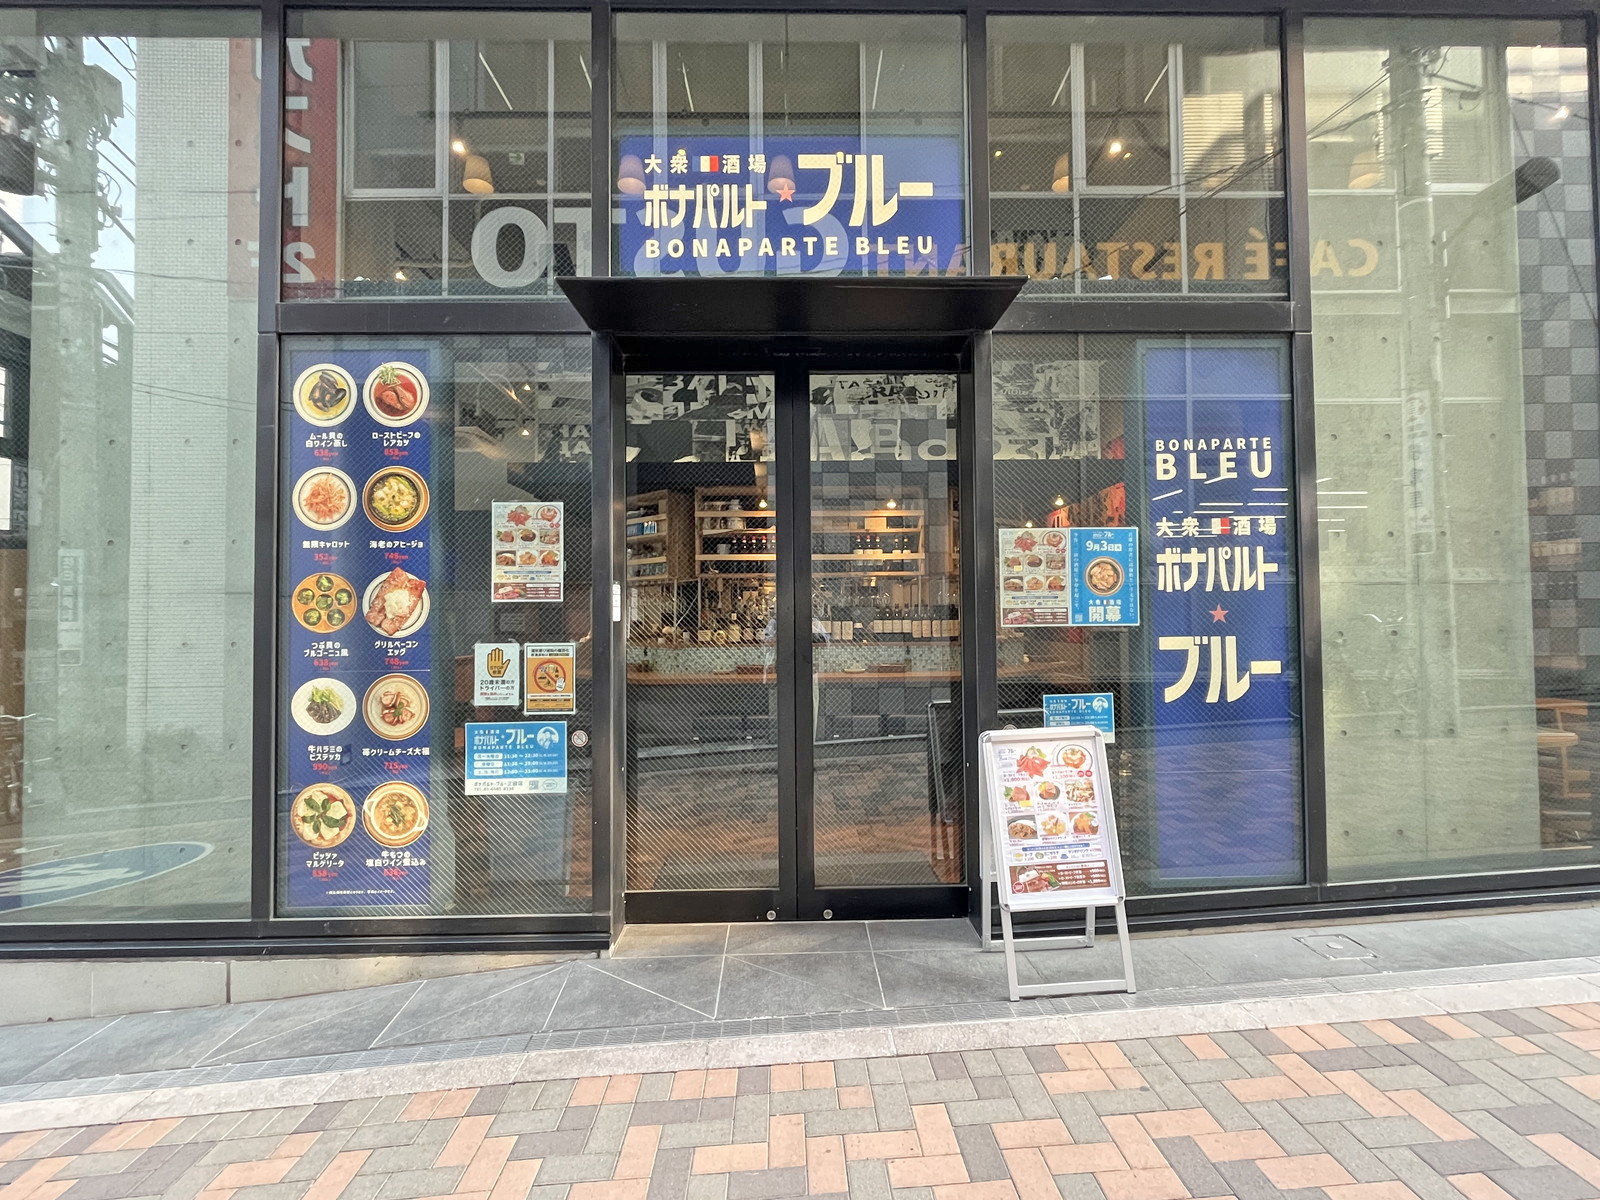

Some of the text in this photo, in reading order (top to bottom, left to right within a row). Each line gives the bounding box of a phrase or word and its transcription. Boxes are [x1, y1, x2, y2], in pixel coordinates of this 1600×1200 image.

[797, 152, 934, 228] ブルー
[643, 183, 768, 229] ボナパルト
[645, 235, 934, 259] BONAPARTE BLEU
[309, 432, 344, 440] ムール貝の
[372, 431, 421, 440] ローストビーフの
[305, 440, 348, 448] 白ワイン蒸し
[1155, 437, 1273, 453] BONAPARTE
[1156, 451, 1273, 481] BLEU
[302, 540, 350, 549] 無限キャロット
[369, 540, 424, 549] 海老のアヒージョ
[1156, 546, 1279, 593] ボナパルト
[1088, 606, 1122, 623] 開幕
[311, 641, 341, 649] つぶ貝の
[374, 640, 419, 648] グリルベーコン
[303, 649, 349, 657] ブルゴーニュ風
[387, 648, 406, 656] エッグ
[1159, 635, 1282, 704] ブルー
[1070, 698, 1092, 710] ブルー
[506, 728, 535, 745] ブルー
[308, 745, 343, 753] 牛ハラミの
[362, 747, 430, 756] 苺クリームチーズ大福
[313, 852, 338, 860] ピッツァ
[306, 860, 345, 868] マルゲリータ
[366, 858, 427, 867] 塩白ワイン煮込み
